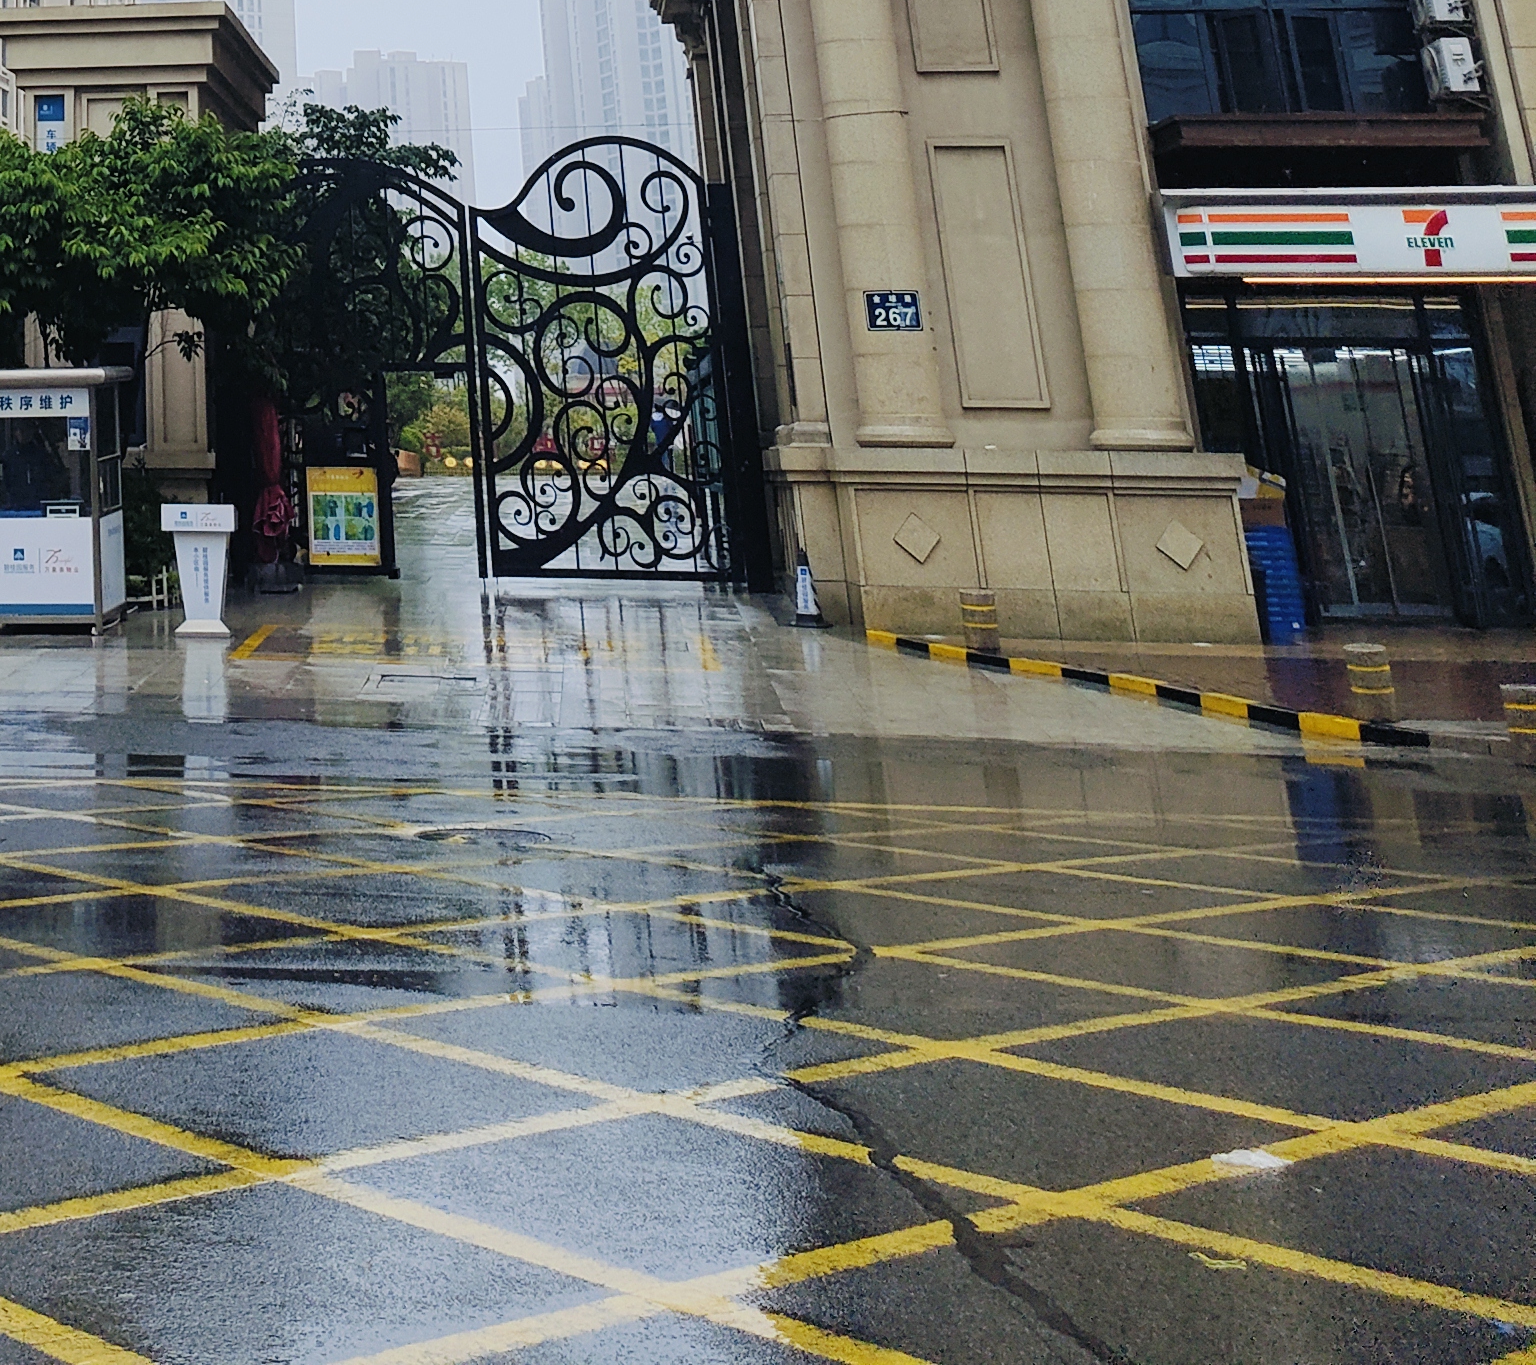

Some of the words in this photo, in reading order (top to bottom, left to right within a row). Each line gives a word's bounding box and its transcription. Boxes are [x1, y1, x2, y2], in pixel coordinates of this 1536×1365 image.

[1401, 209, 1449, 267] 7
[874, 307, 914, 326] 267
[0, 394, 74, 411] 秩序维护
